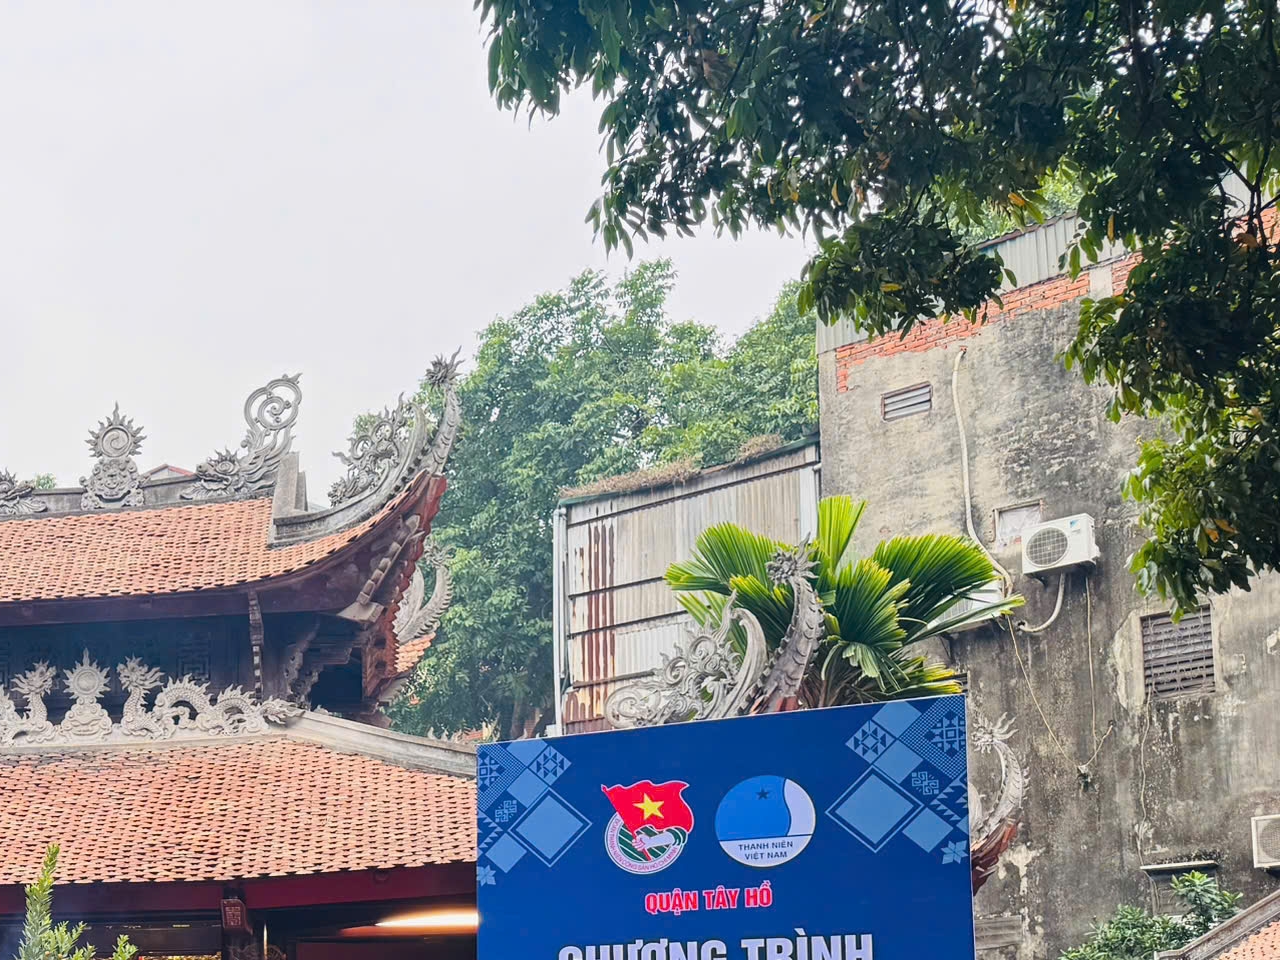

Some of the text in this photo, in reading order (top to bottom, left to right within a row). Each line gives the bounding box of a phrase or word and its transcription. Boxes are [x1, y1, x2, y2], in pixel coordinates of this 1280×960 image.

[738, 839, 794, 851] THANH NIÊN
[745, 851, 787, 861] VIỆT NAM
[645, 880, 772, 915] QUẬN TÂY HỒ
